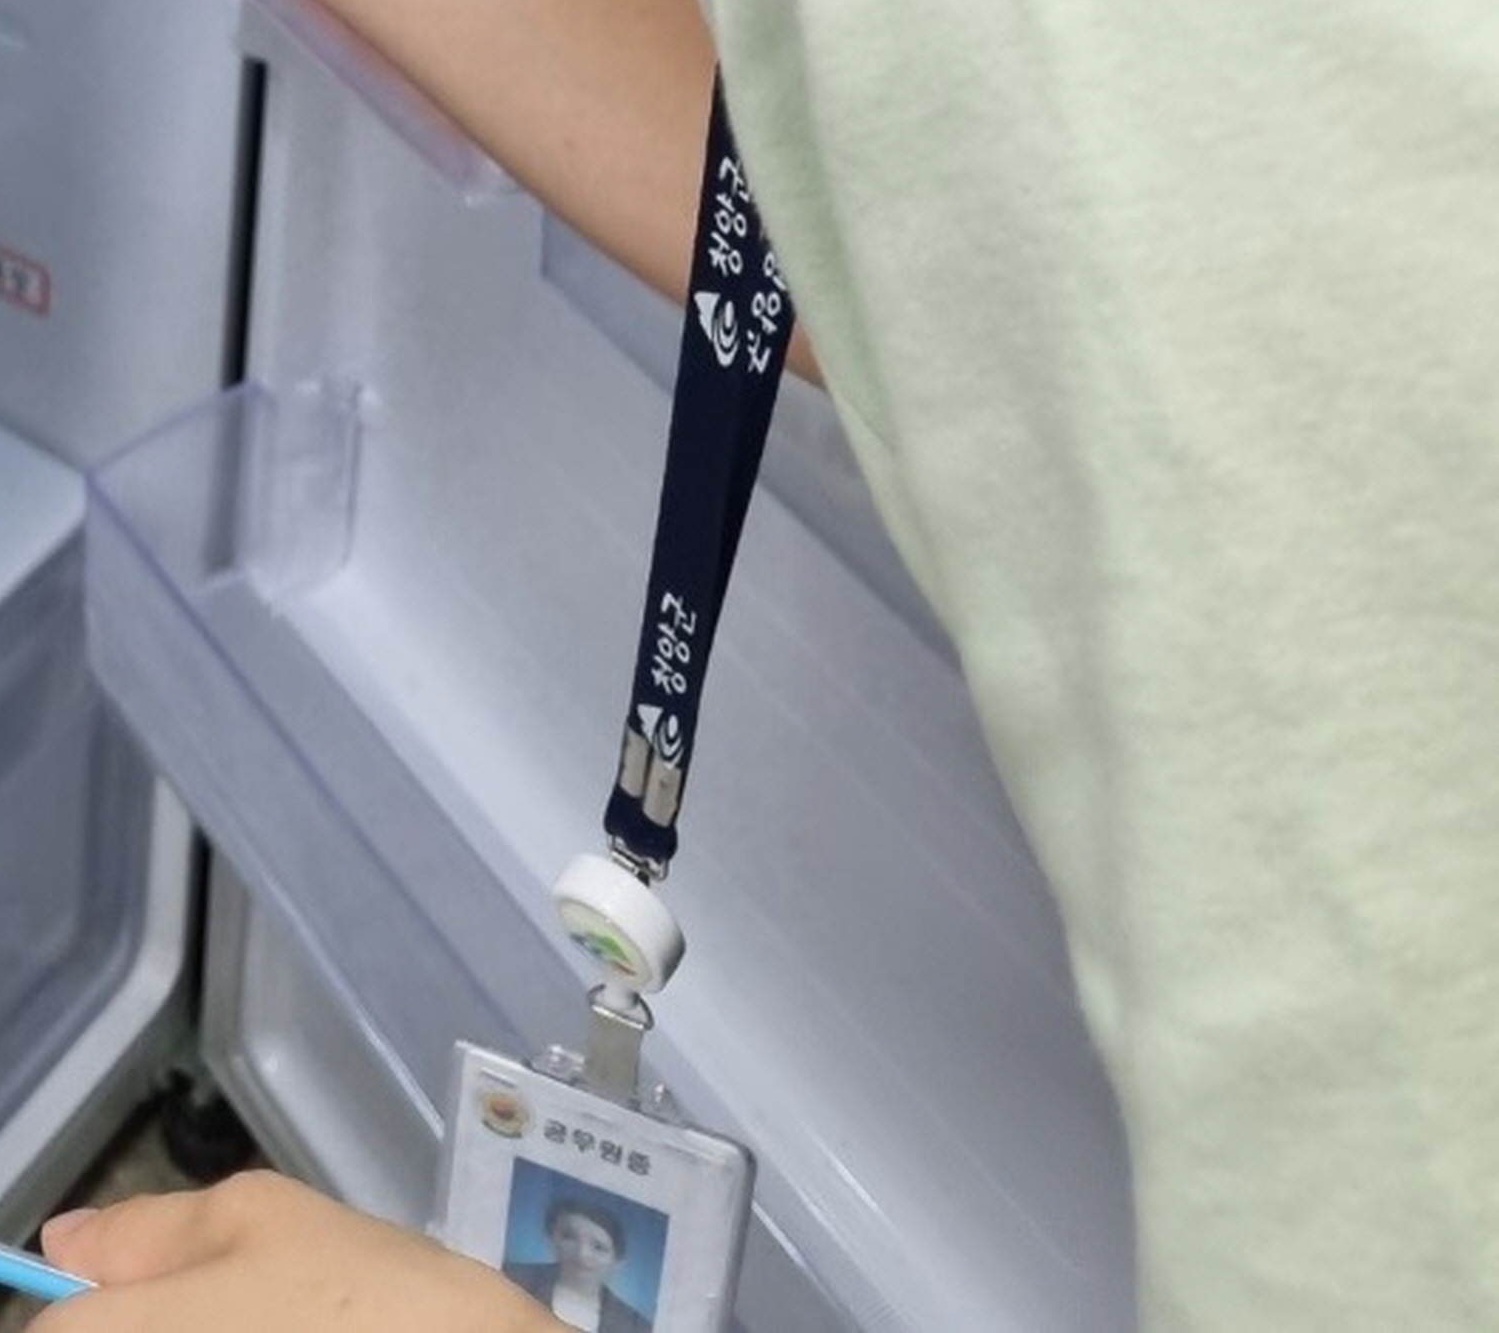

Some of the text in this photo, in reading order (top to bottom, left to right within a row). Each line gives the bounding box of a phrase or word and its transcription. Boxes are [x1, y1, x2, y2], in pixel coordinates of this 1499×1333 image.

[707, 156, 750, 277] 청양군
[650, 591, 697, 696] 청양군
[542, 1116, 652, 1178] 공무원증
